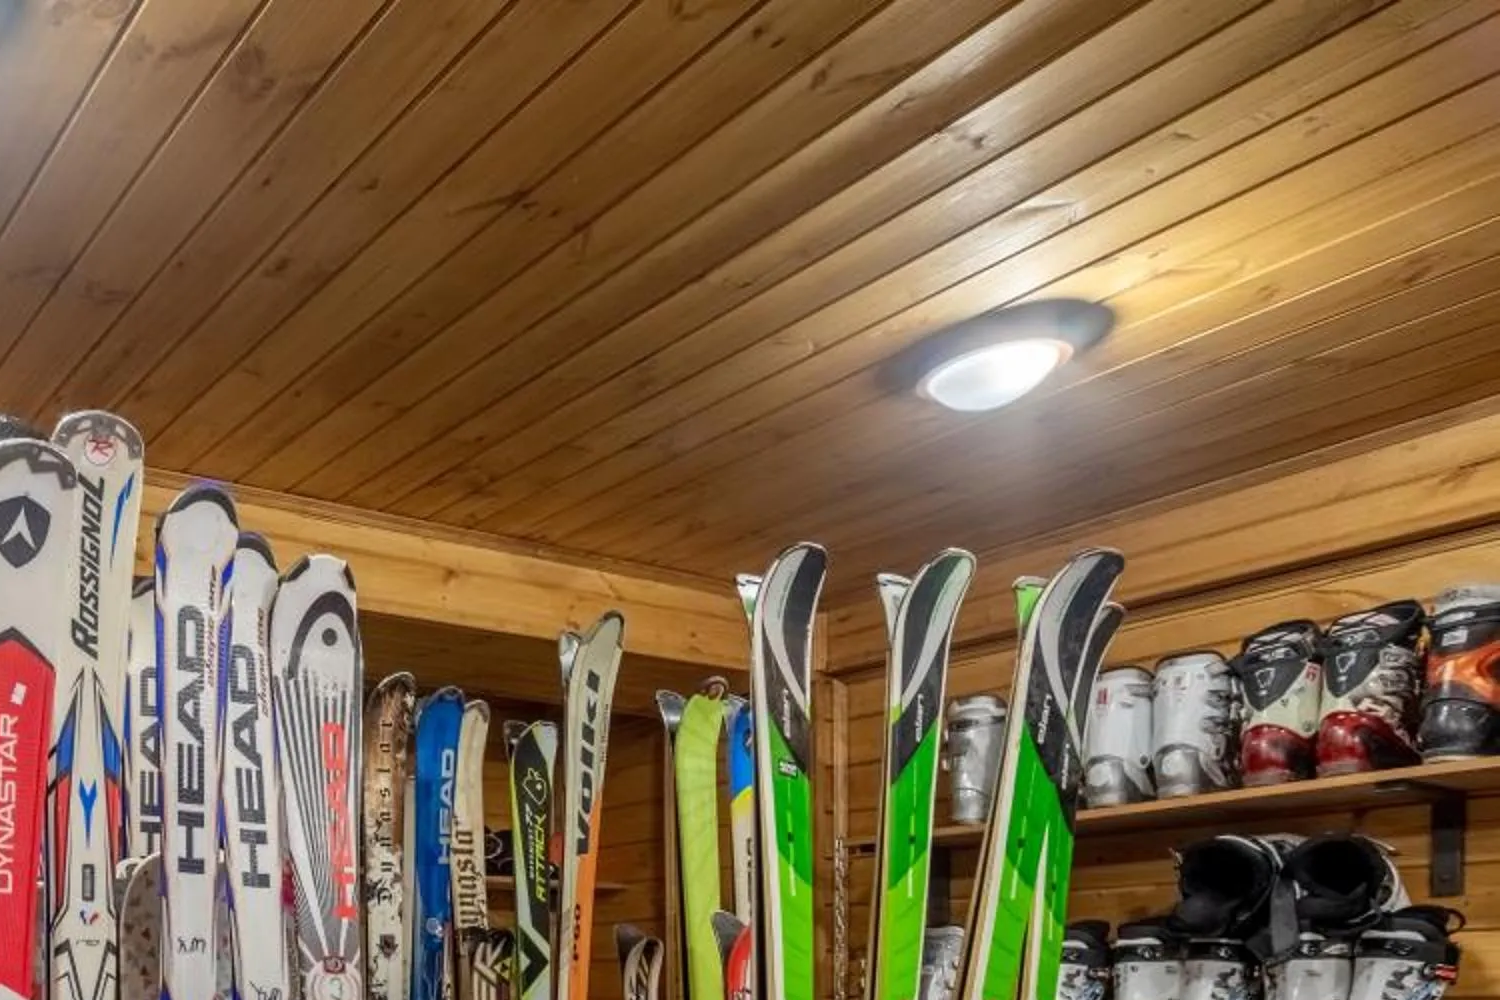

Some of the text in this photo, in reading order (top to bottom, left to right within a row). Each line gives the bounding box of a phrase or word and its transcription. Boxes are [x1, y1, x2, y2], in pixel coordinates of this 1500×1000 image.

[71, 472, 105, 661] ROSSIGNOL
[138, 666, 160, 857] HEAD
[177, 605, 205, 875] HEAD
[231, 645, 270, 889] HEAD
[438, 749, 457, 866] HEAD
[535, 813, 548, 902] ATTACK
